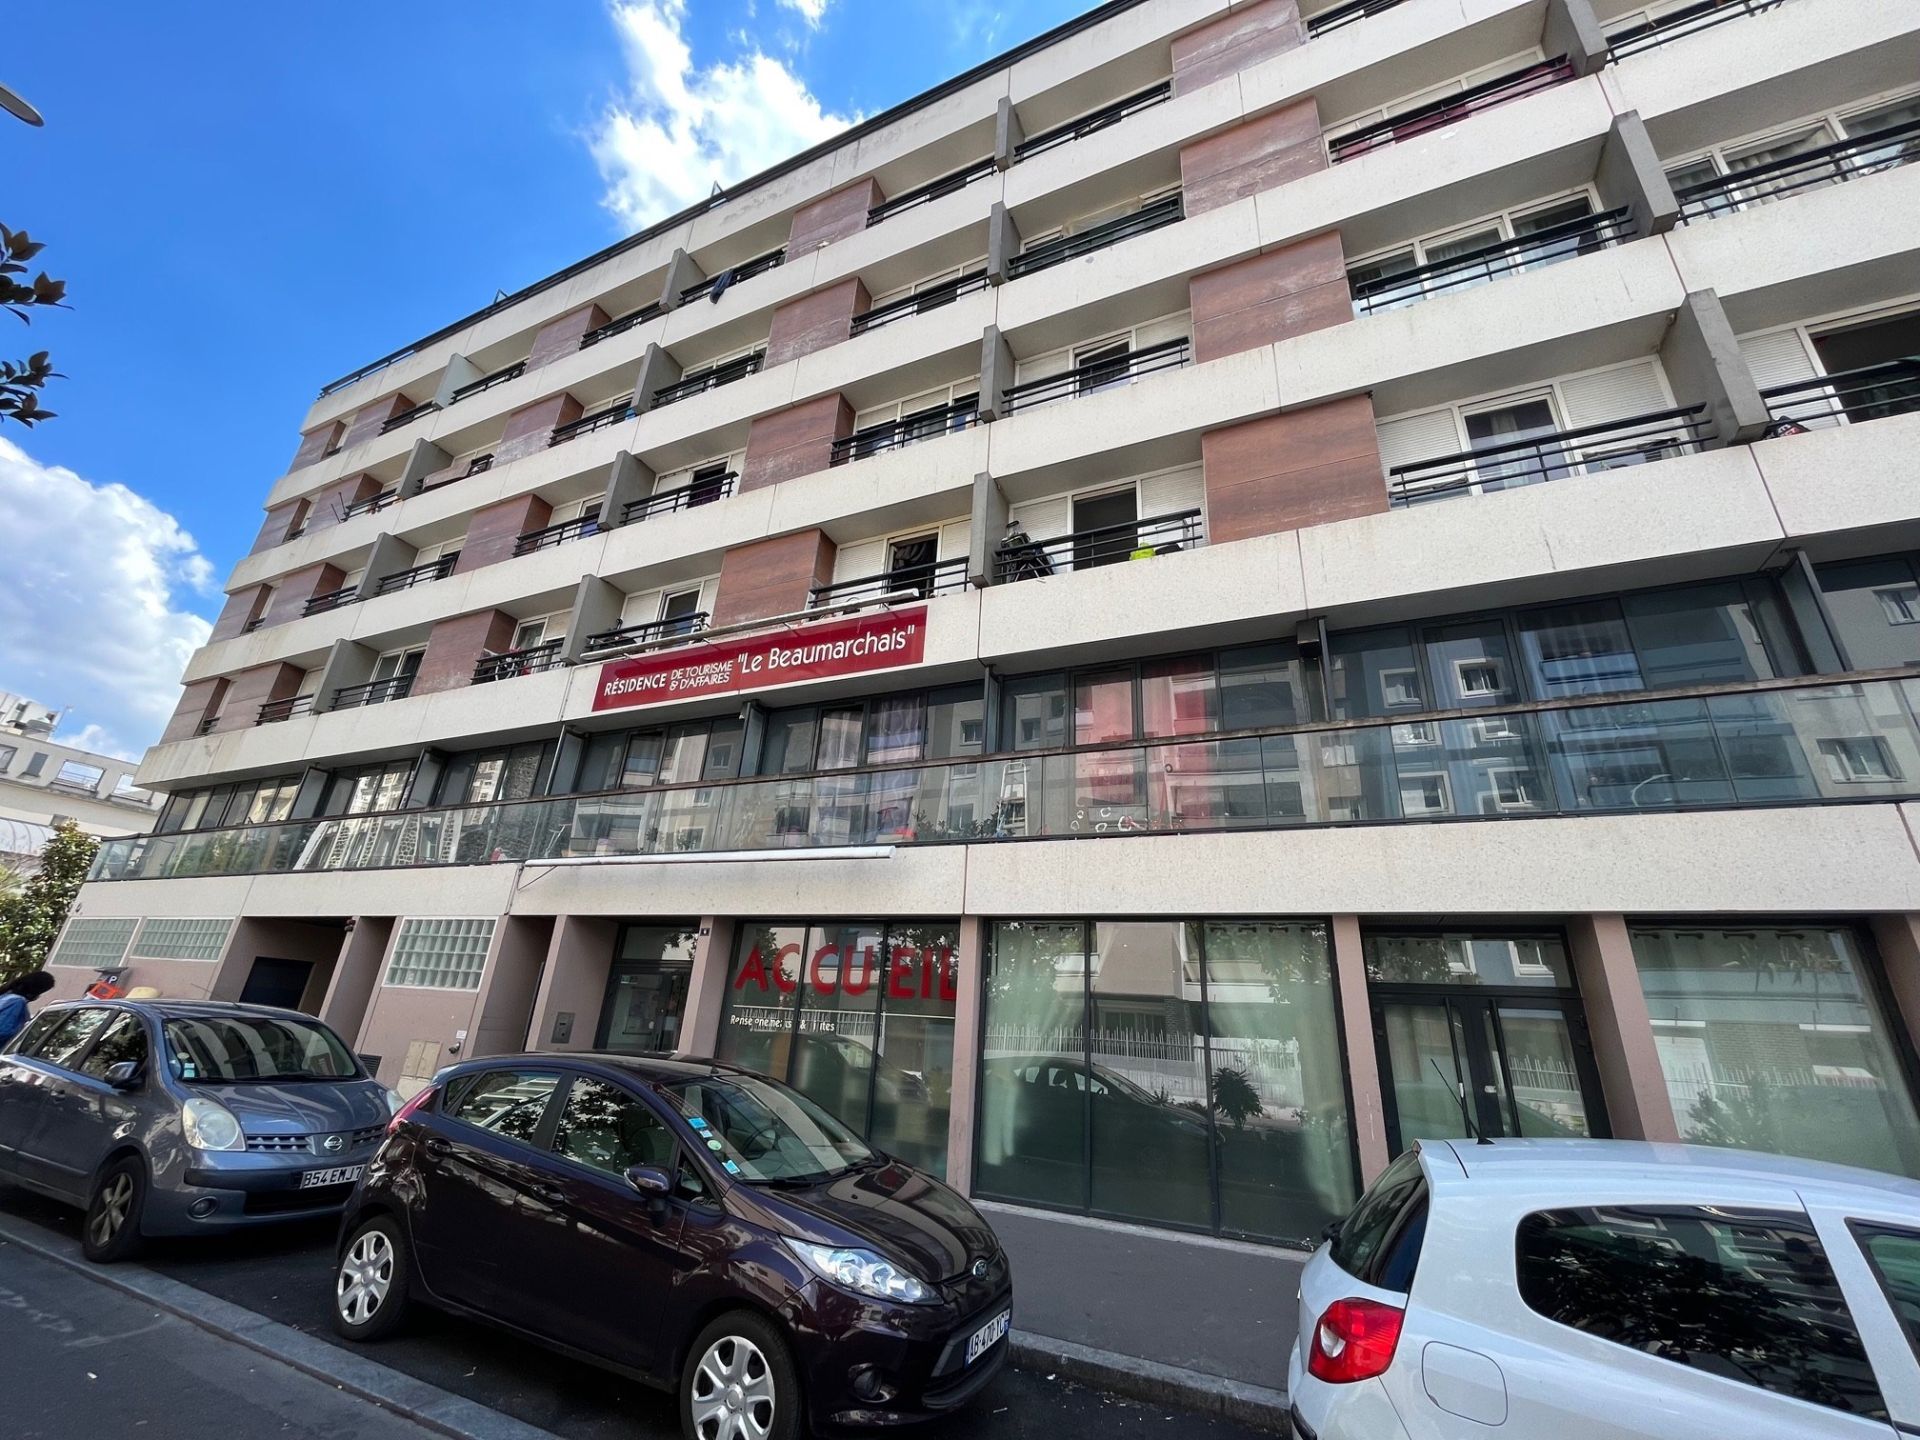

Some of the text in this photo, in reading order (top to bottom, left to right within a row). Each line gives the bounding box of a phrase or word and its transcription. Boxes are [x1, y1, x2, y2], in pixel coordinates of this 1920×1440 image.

[737, 624, 916, 674] "Le Beaumarchais"
[669, 672, 731, 692] & D'AFFAIRES
[671, 660, 734, 680] DE TOURISME
[604, 673, 668, 697] RÉSIDENCE
[734, 942, 957, 1001] ACCUEIL
